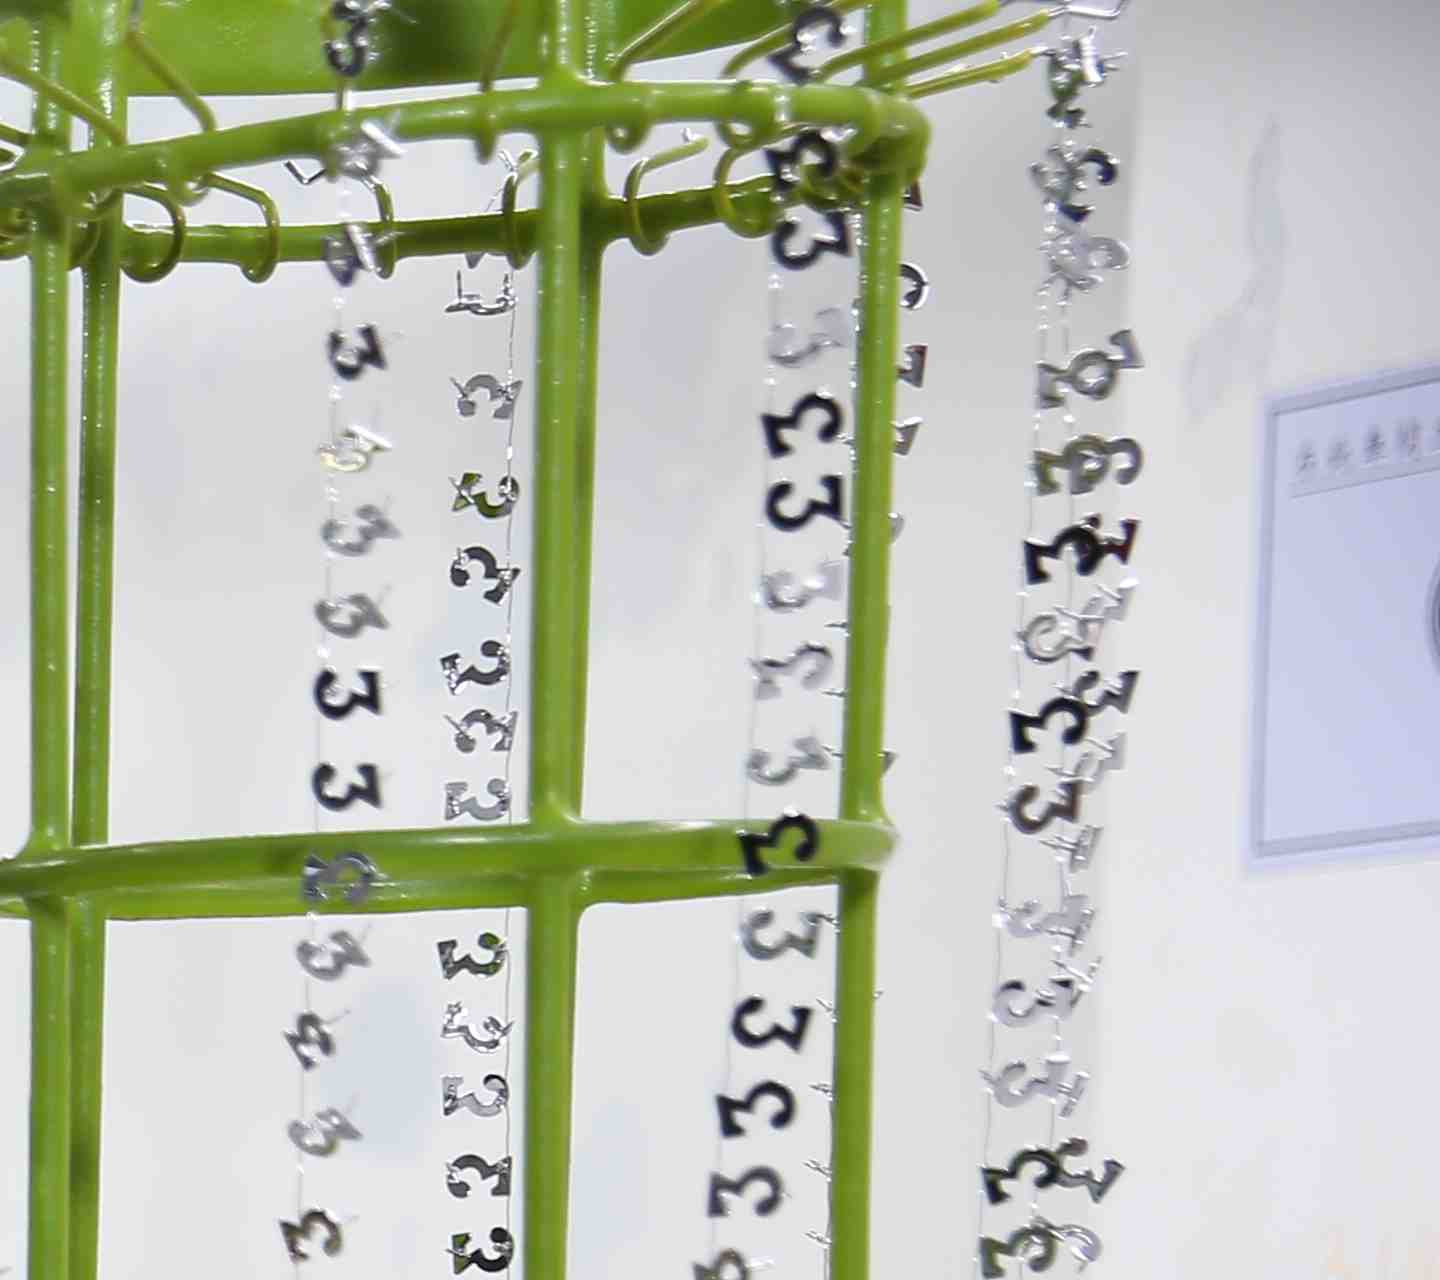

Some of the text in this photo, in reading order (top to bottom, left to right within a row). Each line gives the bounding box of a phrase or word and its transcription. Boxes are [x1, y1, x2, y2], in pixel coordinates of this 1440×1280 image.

[772, 209, 852, 270] 3
[327, 325, 387, 380] 3
[761, 393, 844, 458] 3
[322, 504, 402, 556] 3
[765, 475, 844, 531] 3
[1023, 524, 1103, 585] 3
[314, 593, 390, 638] 3
[313, 668, 383, 720] 3
[748, 643, 832, 701] 3
[1009, 697, 1088, 754] 3
[312, 763, 382, 811] 3
[747, 736, 829, 786] 3
[1010, 783, 1078, 834] 3
[738, 811, 819, 876] 3
[297, 930, 370, 980] 3
[740, 910, 822, 960] 3
[732, 996, 812, 1053] 3
[288, 1107, 362, 1156] 3
[716, 1081, 796, 1139] 3
[708, 1165, 781, 1217] 3
[981, 1148, 1059, 1205] 3
[279, 1210, 343, 1264] 3
[981, 1225, 1056, 1280] 3
